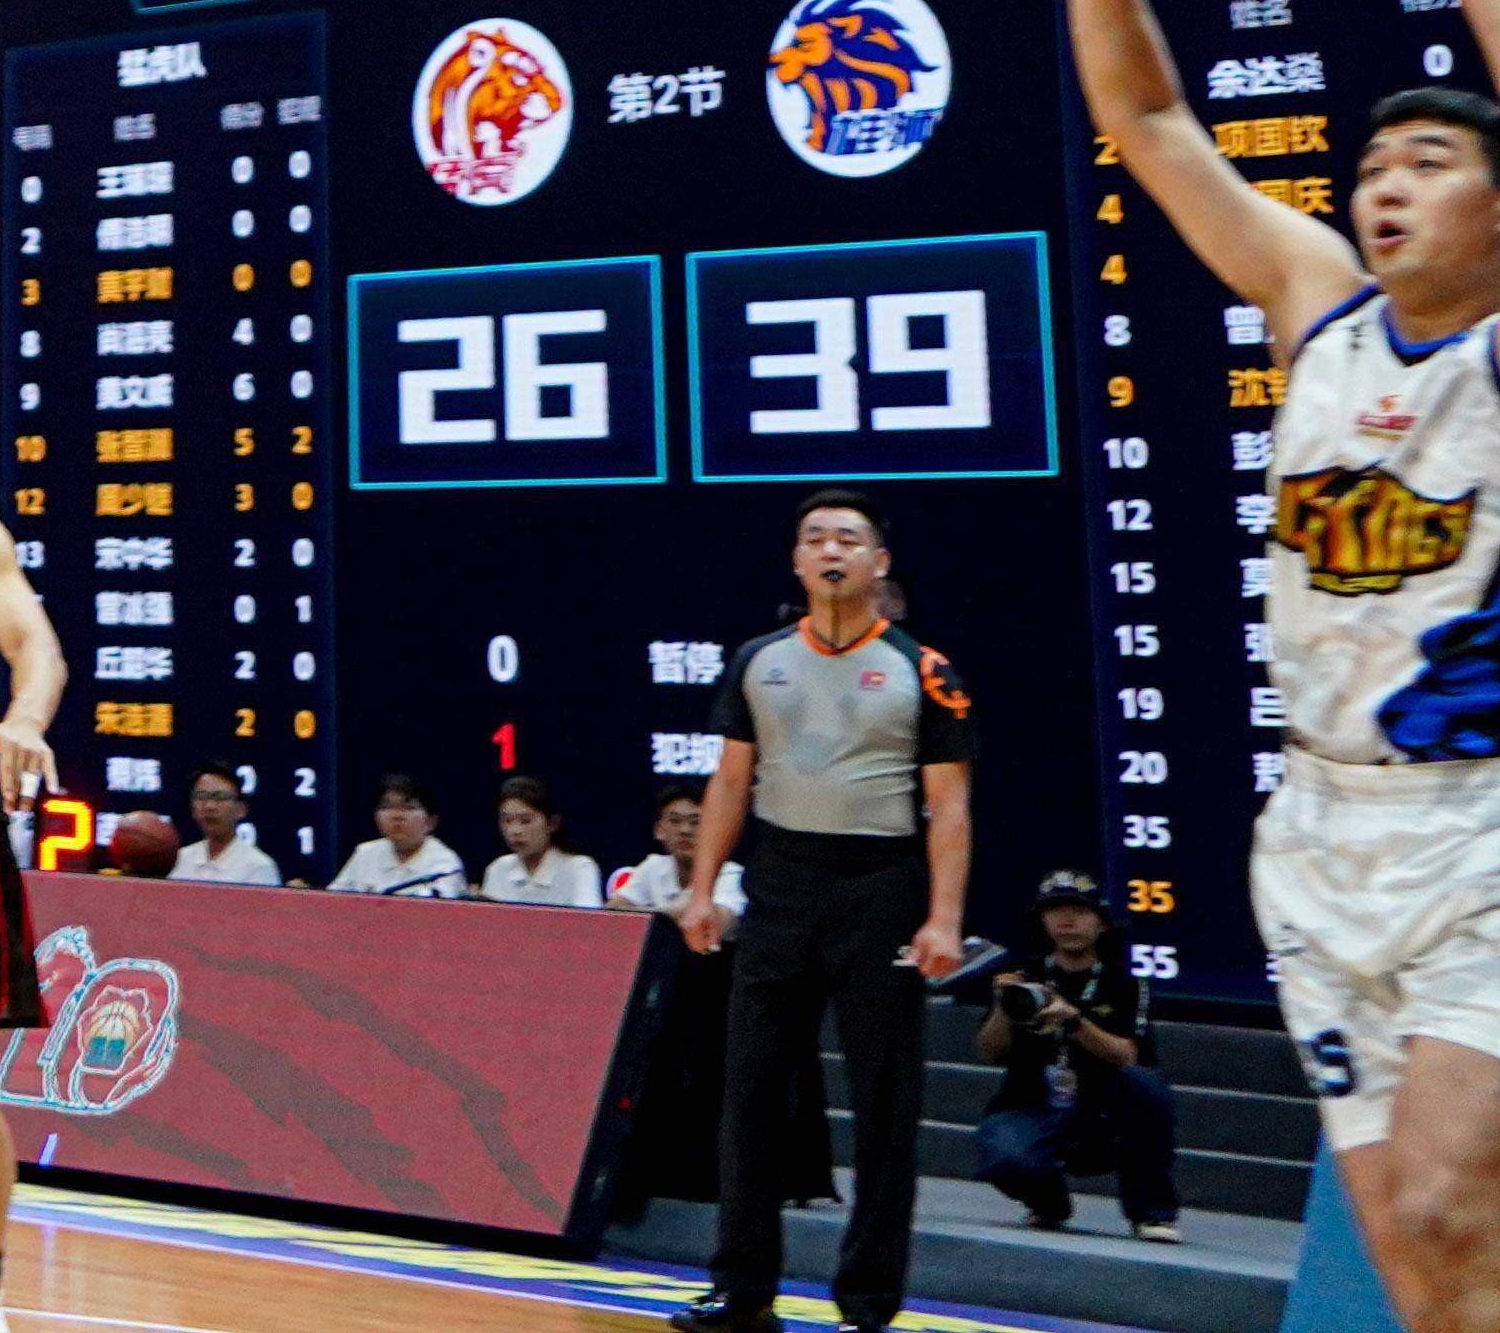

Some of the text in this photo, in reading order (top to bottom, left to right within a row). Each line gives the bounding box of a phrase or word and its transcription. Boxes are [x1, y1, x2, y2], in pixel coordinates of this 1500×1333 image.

[1423, 44, 1454, 77] 0
[607, 65, 725, 124] 第2节
[232, 155, 255, 184] 0
[288, 150, 312, 179] 0
[1097, 195, 1125, 225] 4
[20, 204, 313, 255] 2 0 0
[21, 278, 41, 306] 3
[232, 263, 256, 292] 0
[289, 259, 313, 288] 0
[1100, 254, 1128, 284] 4
[20, 314, 313, 358] 8 4 0
[1104, 314, 1132, 347] 8
[397, 308, 610, 445] 26
[746, 289, 992, 436] 39
[19, 382, 41, 411] 9
[232, 372, 256, 402] 6
[290, 369, 314, 399] 0
[1107, 375, 1135, 408] 9
[14, 435, 47, 464] 10
[233, 426, 256, 456] 5
[291, 425, 314, 455] 2
[1103, 436, 1150, 470] 10
[14, 488, 47, 516] 12
[233, 483, 256, 512] 3
[291, 481, 315, 511] 0
[1107, 498, 1153, 532] 12
[233, 538, 257, 568] 2
[291, 537, 315, 568] 0
[1110, 561, 1156, 595] 15
[233, 594, 257, 625] 0
[294, 594, 313, 624] 1
[1113, 624, 1160, 657] 15
[233, 650, 257, 681] 2
[292, 650, 316, 682] 0
[487, 635, 726, 685] 0 暂停
[1117, 687, 1164, 721] 19
[234, 707, 317, 740] 2 0
[491, 722, 515, 770] 1
[294, 767, 317, 798] 2
[1118, 750, 1167, 785] 20
[296, 824, 315, 856] 1
[1122, 814, 1172, 849] 35
[1127, 878, 1176, 914] 35
[1130, 943, 1180, 980] 55
